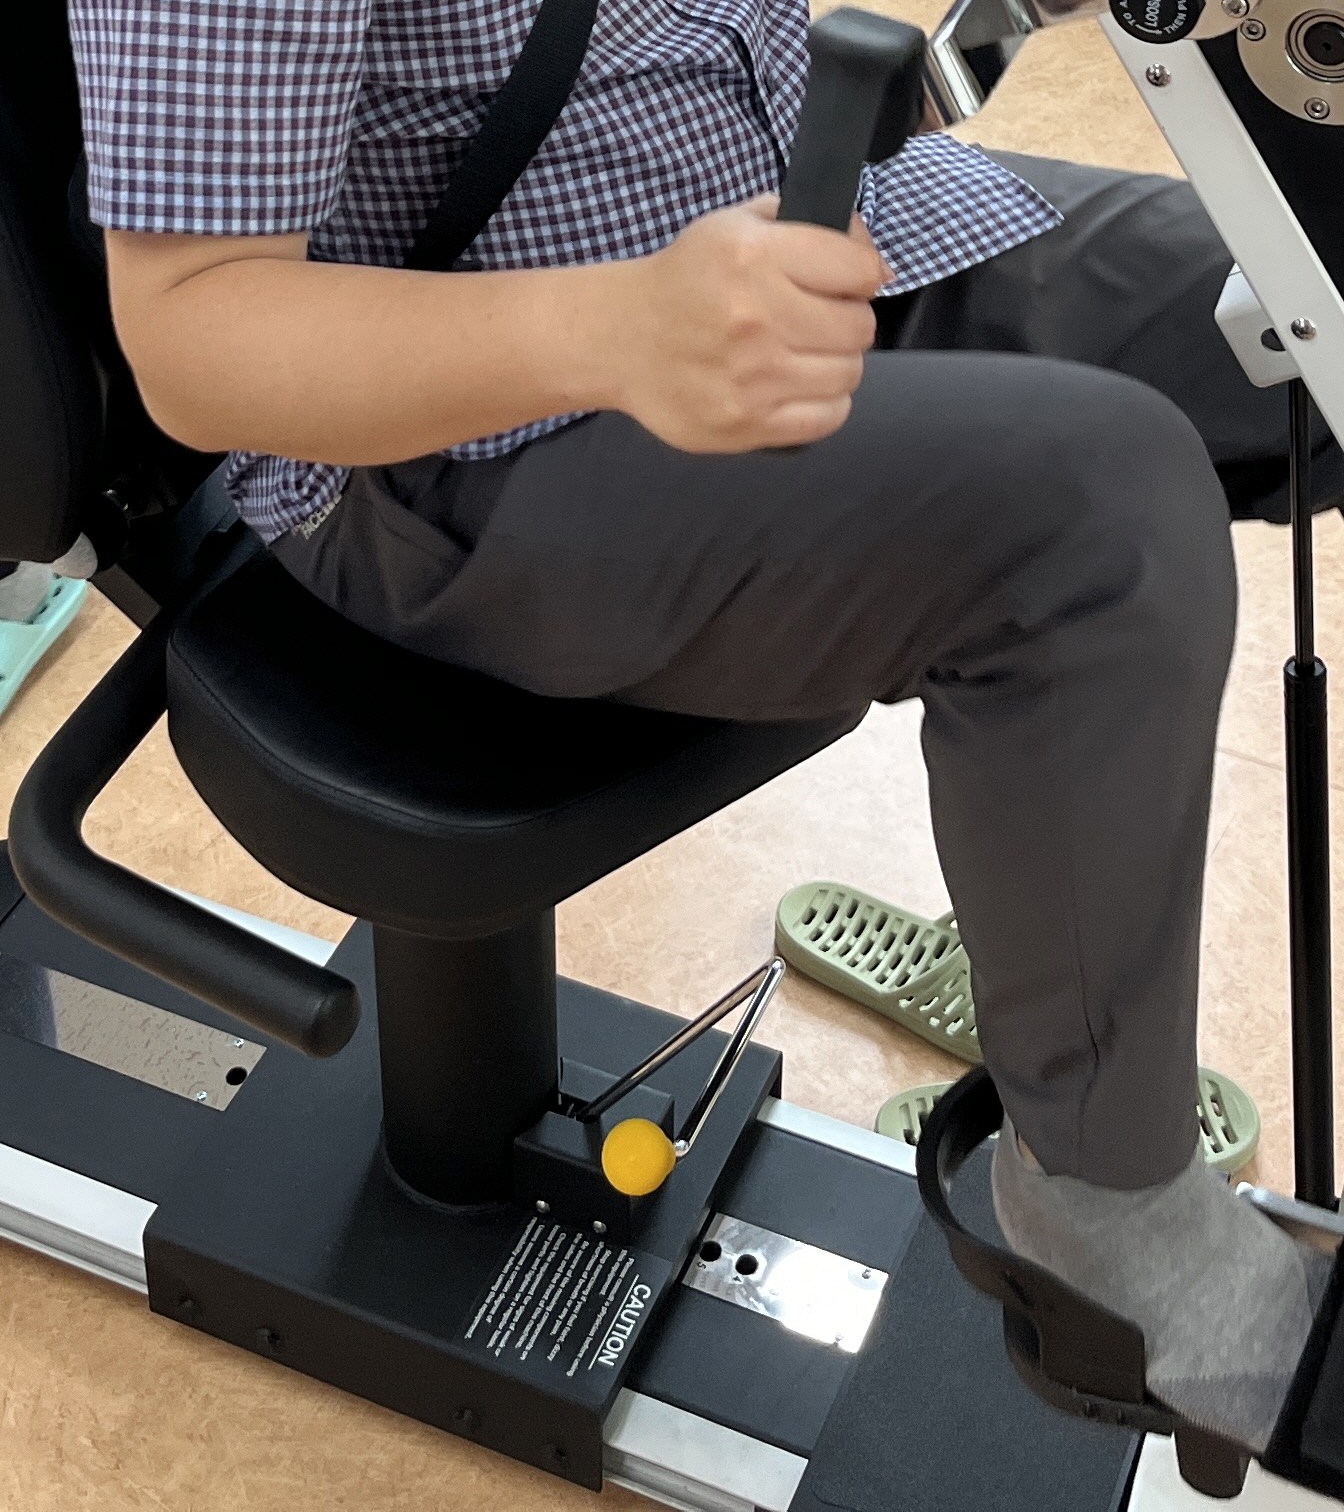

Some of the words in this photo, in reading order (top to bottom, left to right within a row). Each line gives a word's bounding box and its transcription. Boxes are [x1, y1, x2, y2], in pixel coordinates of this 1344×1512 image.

[1123, 12, 1136, 26] TO
[1164, 12, 1187, 34] THEN
[597, 1284, 652, 1366] CAUTION
